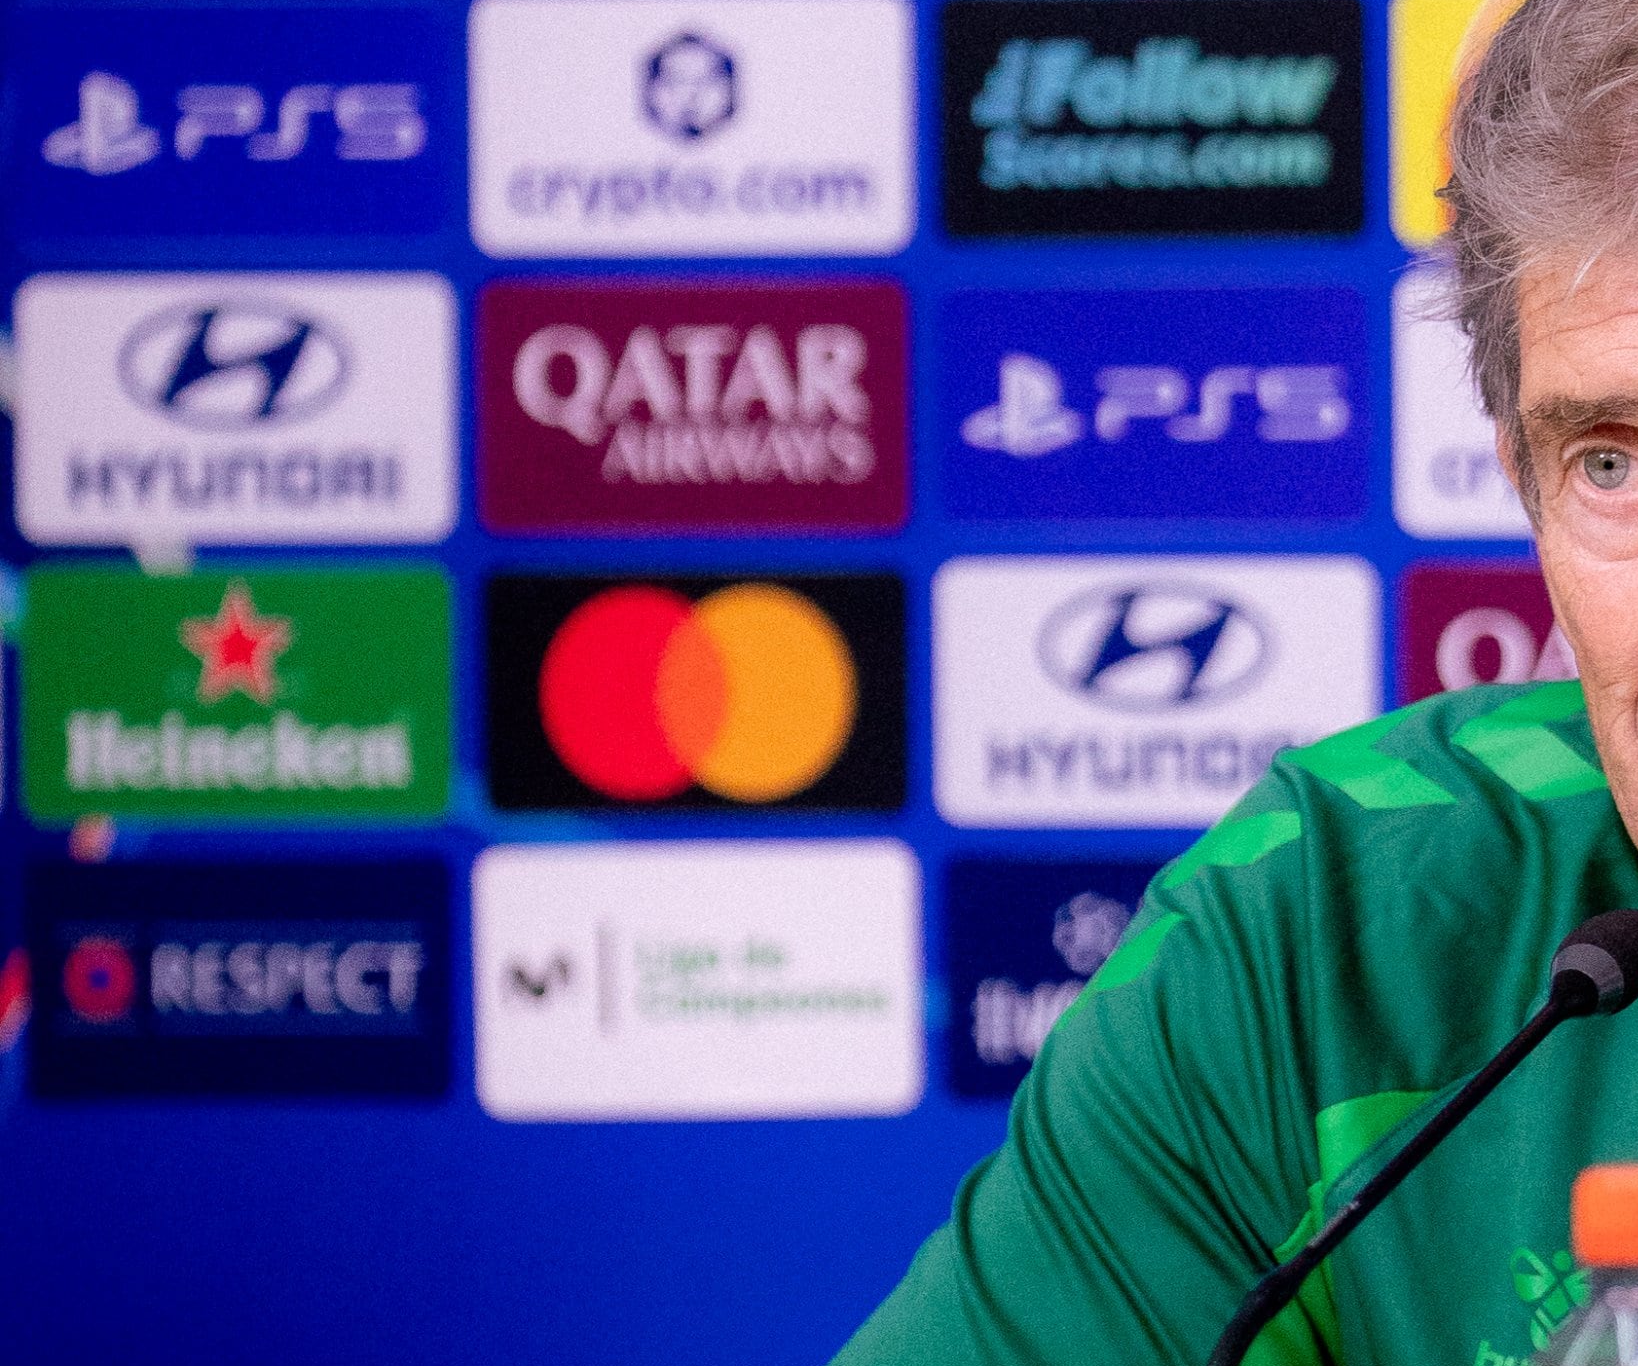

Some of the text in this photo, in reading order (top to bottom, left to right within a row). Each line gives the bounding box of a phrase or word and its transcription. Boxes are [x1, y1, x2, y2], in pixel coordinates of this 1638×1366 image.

[176, 85, 426, 161] PS5
[507, 159, 872, 225] crypto.com
[980, 131, 1335, 191] Scores.com
[513, 324, 869, 443] QATAR
[1096, 365, 1349, 440] PS5
[68, 450, 404, 508] HYUNDAI
[603, 425, 876, 485] AIRWAYS
[66, 710, 412, 792] Heineken
[988, 733, 1300, 792] HYUND
[150, 942, 422, 1016] RESPECT
